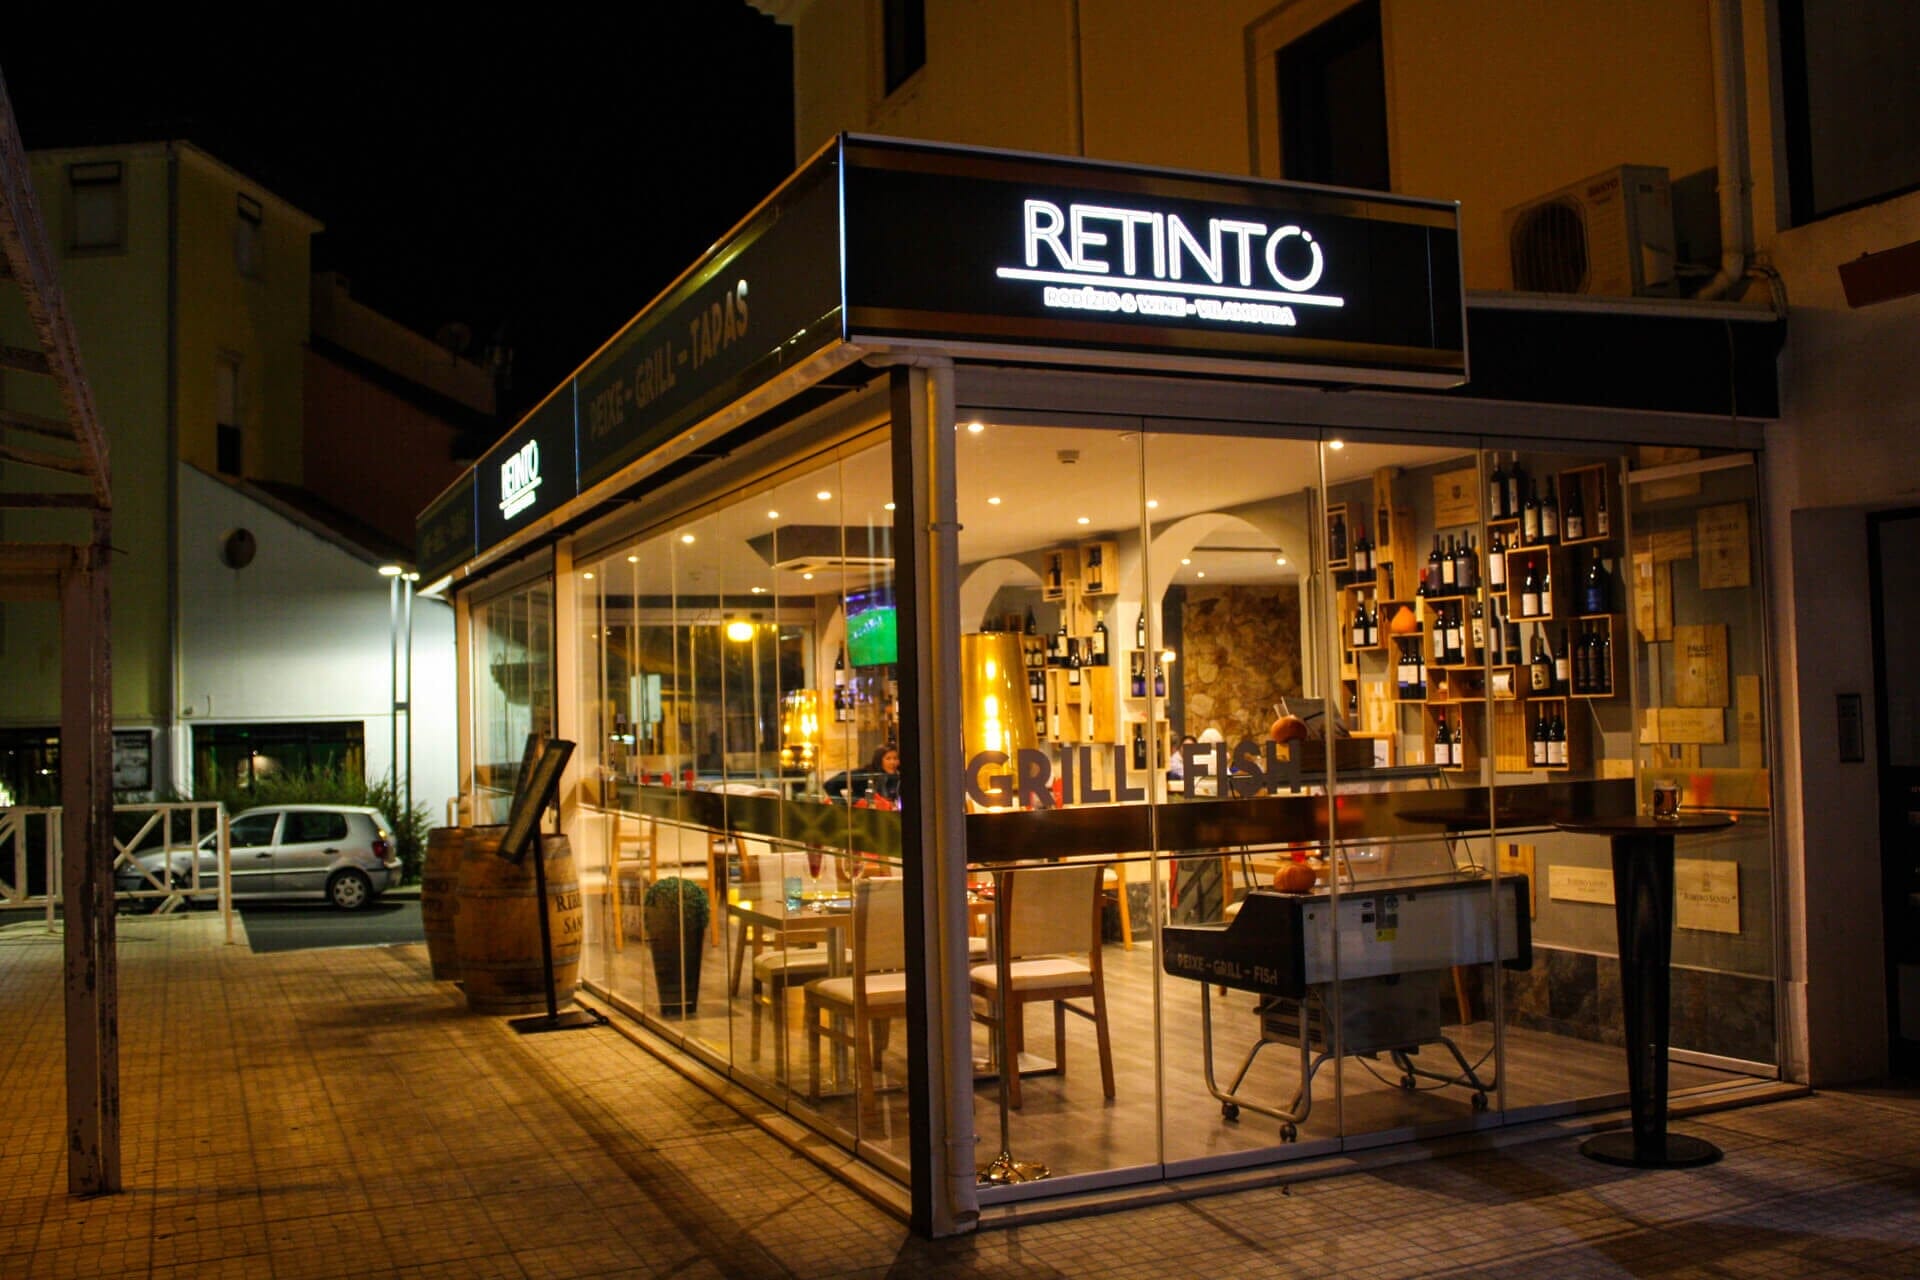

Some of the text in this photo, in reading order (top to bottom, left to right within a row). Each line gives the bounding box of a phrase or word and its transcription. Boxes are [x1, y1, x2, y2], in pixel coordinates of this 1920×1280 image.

[1024, 199, 1324, 292] RETINTO
[635, 340, 676, 408] GRILL
[689, 279, 749, 369] TAPAS
[965, 738, 1301, 808] GRILL FISH
[1214, 960, 1243, 979] GRILL
[1254, 965, 1278, 985] FISH
